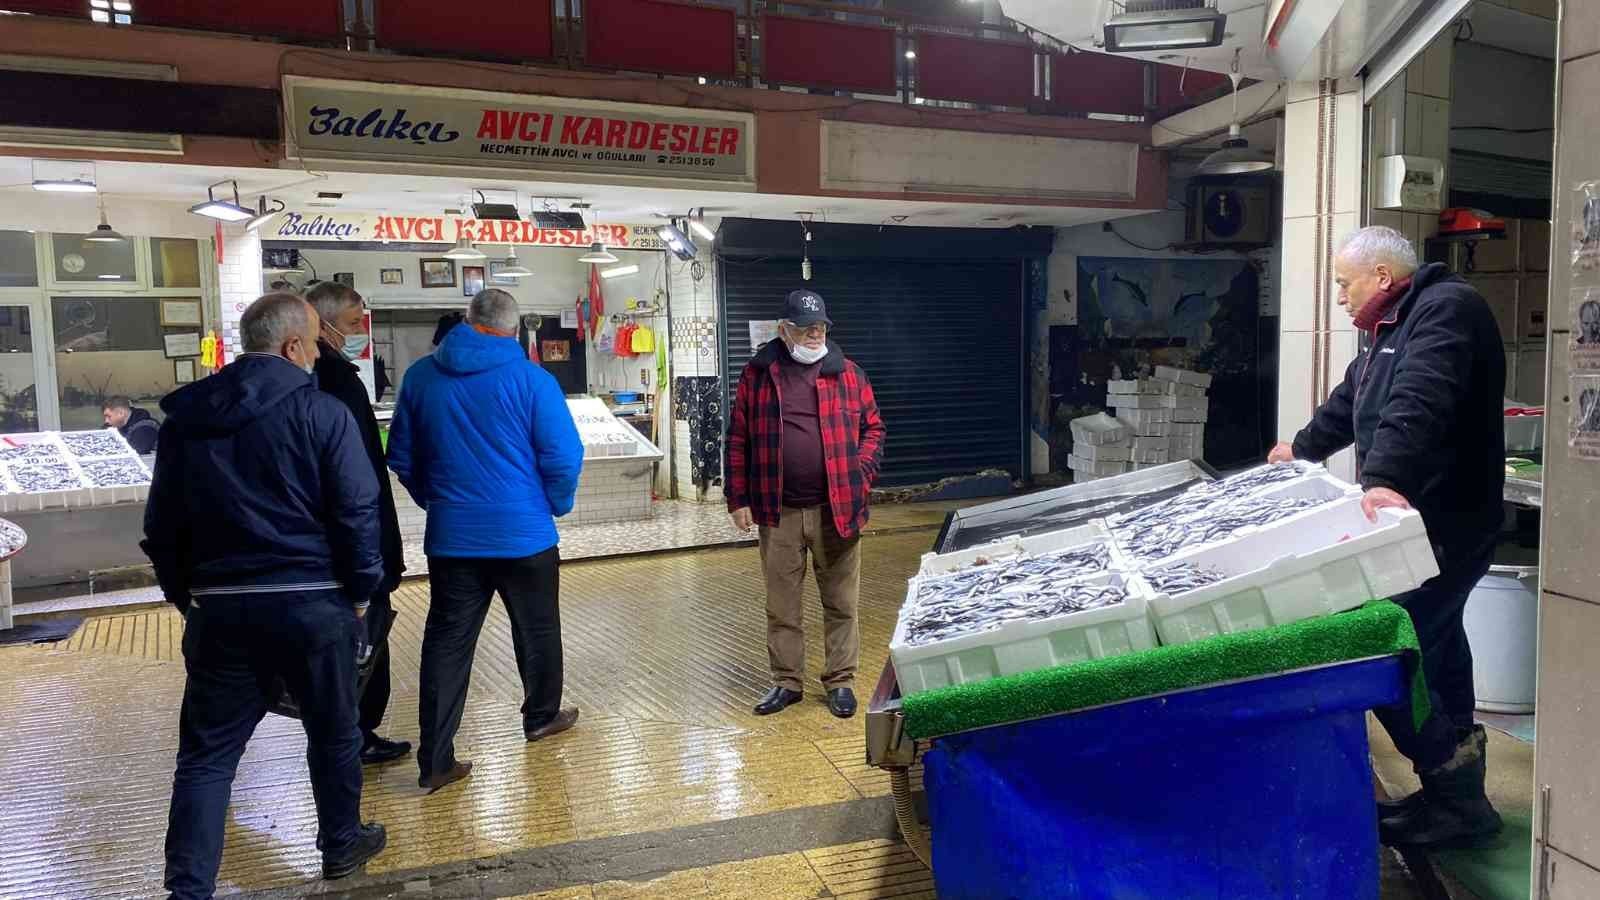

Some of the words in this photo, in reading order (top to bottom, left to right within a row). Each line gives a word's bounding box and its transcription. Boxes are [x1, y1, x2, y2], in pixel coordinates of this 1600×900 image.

[308, 105, 460, 145] Balıkçı
[476, 109, 554, 143] AVCI
[560, 114, 739, 155] KARDEŞLER
[551, 147, 578, 159] AVCI
[278, 212, 360, 240] Balıkçı
[374, 215, 444, 241] AVCI
